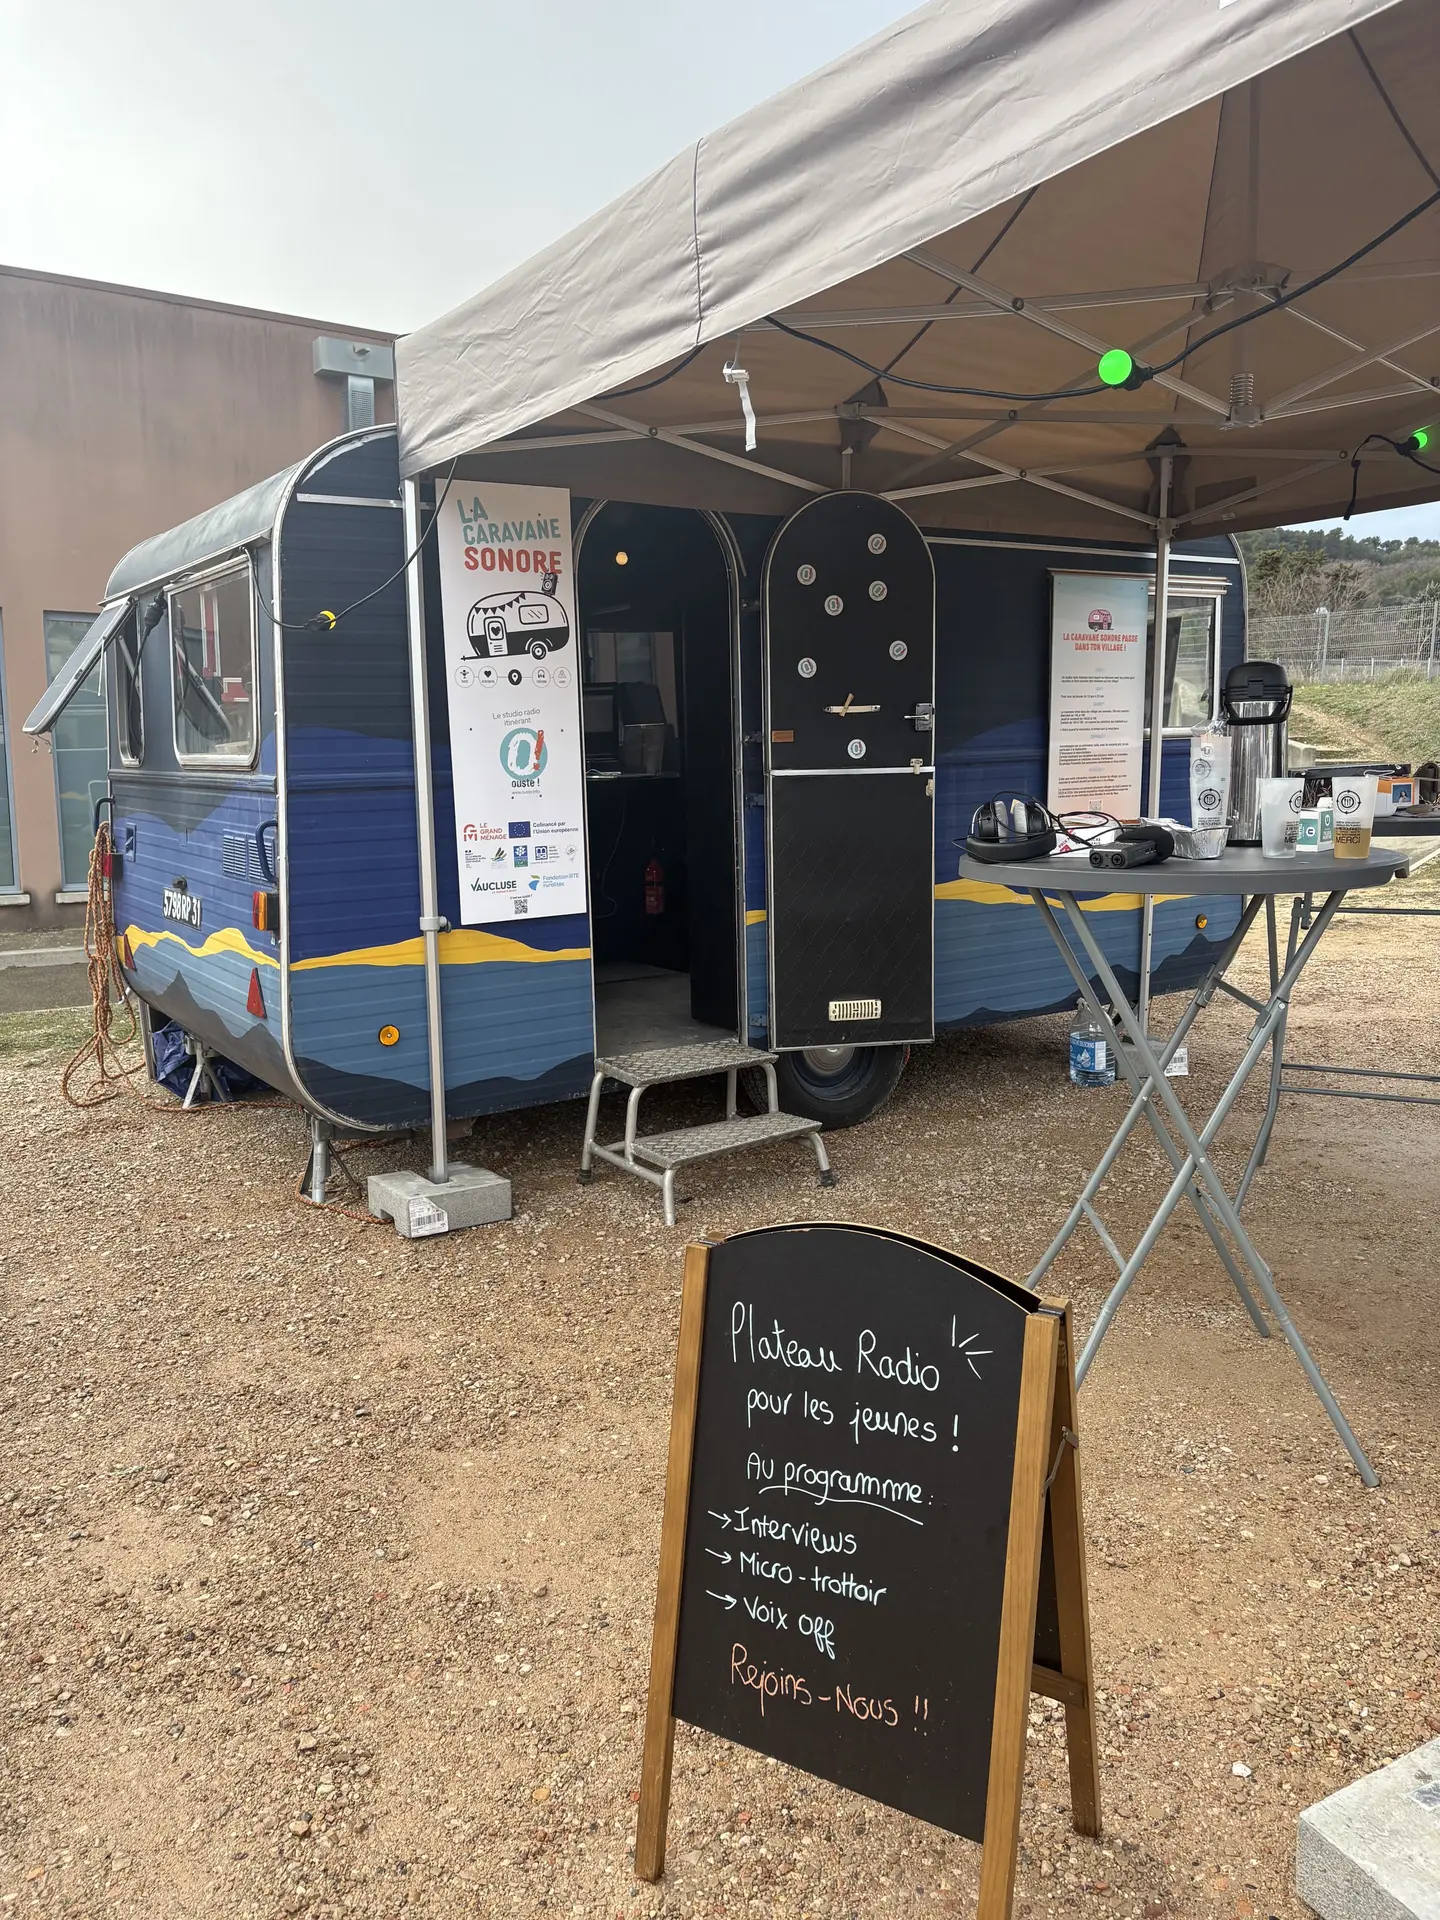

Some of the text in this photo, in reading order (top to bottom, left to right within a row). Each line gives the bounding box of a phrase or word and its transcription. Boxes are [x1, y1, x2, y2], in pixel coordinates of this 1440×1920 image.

[457, 497, 488, 524] LA
[463, 518, 561, 546] CARAVANE
[464, 546, 563, 575] SONORE
[1063, 633, 1070, 641] LA
[1071, 634, 1099, 642] CARAVANE
[1100, 634, 1121, 642] SONORE
[1075, 643, 1089, 651] DANS
[1090, 643, 1100, 651] TON
[1102, 643, 1123, 652] VILLAGE
[492, 708, 541, 720] Le studio radio
[511, 778, 534, 788] ouste
[470, 877, 517, 892] VAUCLUSE
[192, 897, 201, 927] 31
[732, 1301, 940, 1392] Plateau Radio
[747, 1388, 960, 1453] pour les jeunes !
[733, 1506, 858, 1555] Interviews
[743, 1597, 789, 1630] Voix
